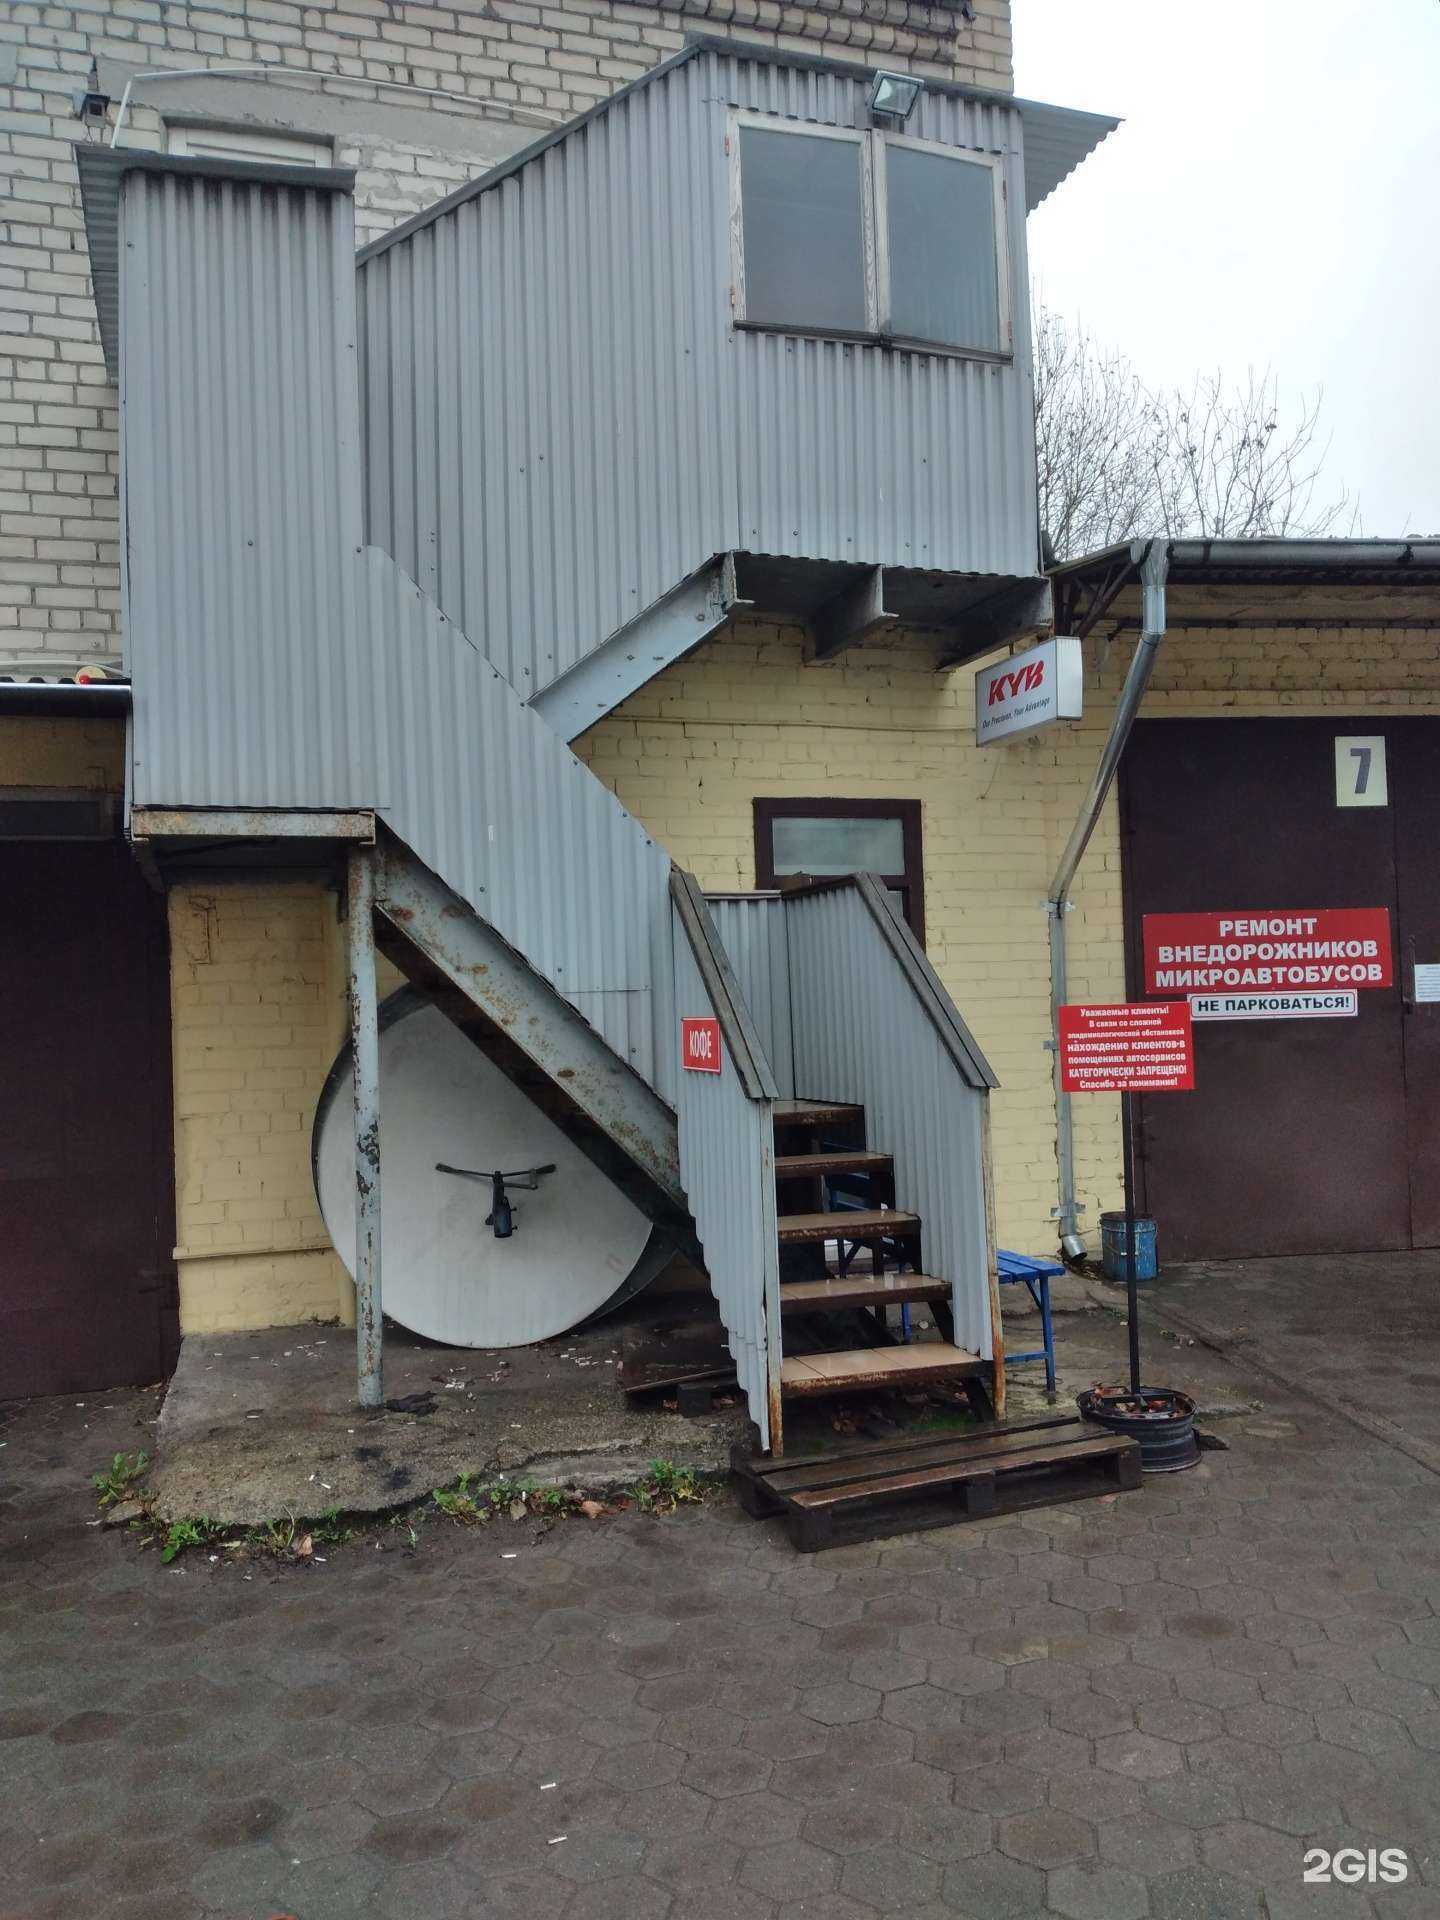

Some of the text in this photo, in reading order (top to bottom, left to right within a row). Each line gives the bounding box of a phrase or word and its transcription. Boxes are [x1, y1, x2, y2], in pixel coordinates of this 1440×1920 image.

[988, 660, 1044, 706] KYB
[1025, 697, 1050, 712] Advantage
[1350, 748, 1372, 794] 7
[1219, 918, 1318, 937] РЕМОНТ
[1158, 940, 1378, 965] ВНЕДОРОЖНИКОВ
[1155, 964, 1383, 987] МИКРОАВТОБУСОВ
[1080, 1006, 1169, 1017] Уважаемые клиенты!
[1198, 996, 1350, 1012] НЕ ПАРКОВАТЬСЯ!
[1142, 1028, 1184, 1036] обстановкой
[690, 1028, 711, 1060] КОФЕ
[1068, 1041, 1128, 1052] нахождение
[1132, 1041, 1176, 1049] клиентов
[1068, 1054, 1186, 1065] помещениях автосервисов
[1069, 1064, 1186, 1078] КАТЕГОРИЧЕСКИ ЗАПРЕЩЕНО!
[1080, 1079, 1115, 1089] Спасибо
[1129, 1077, 1177, 1087] понимание!
